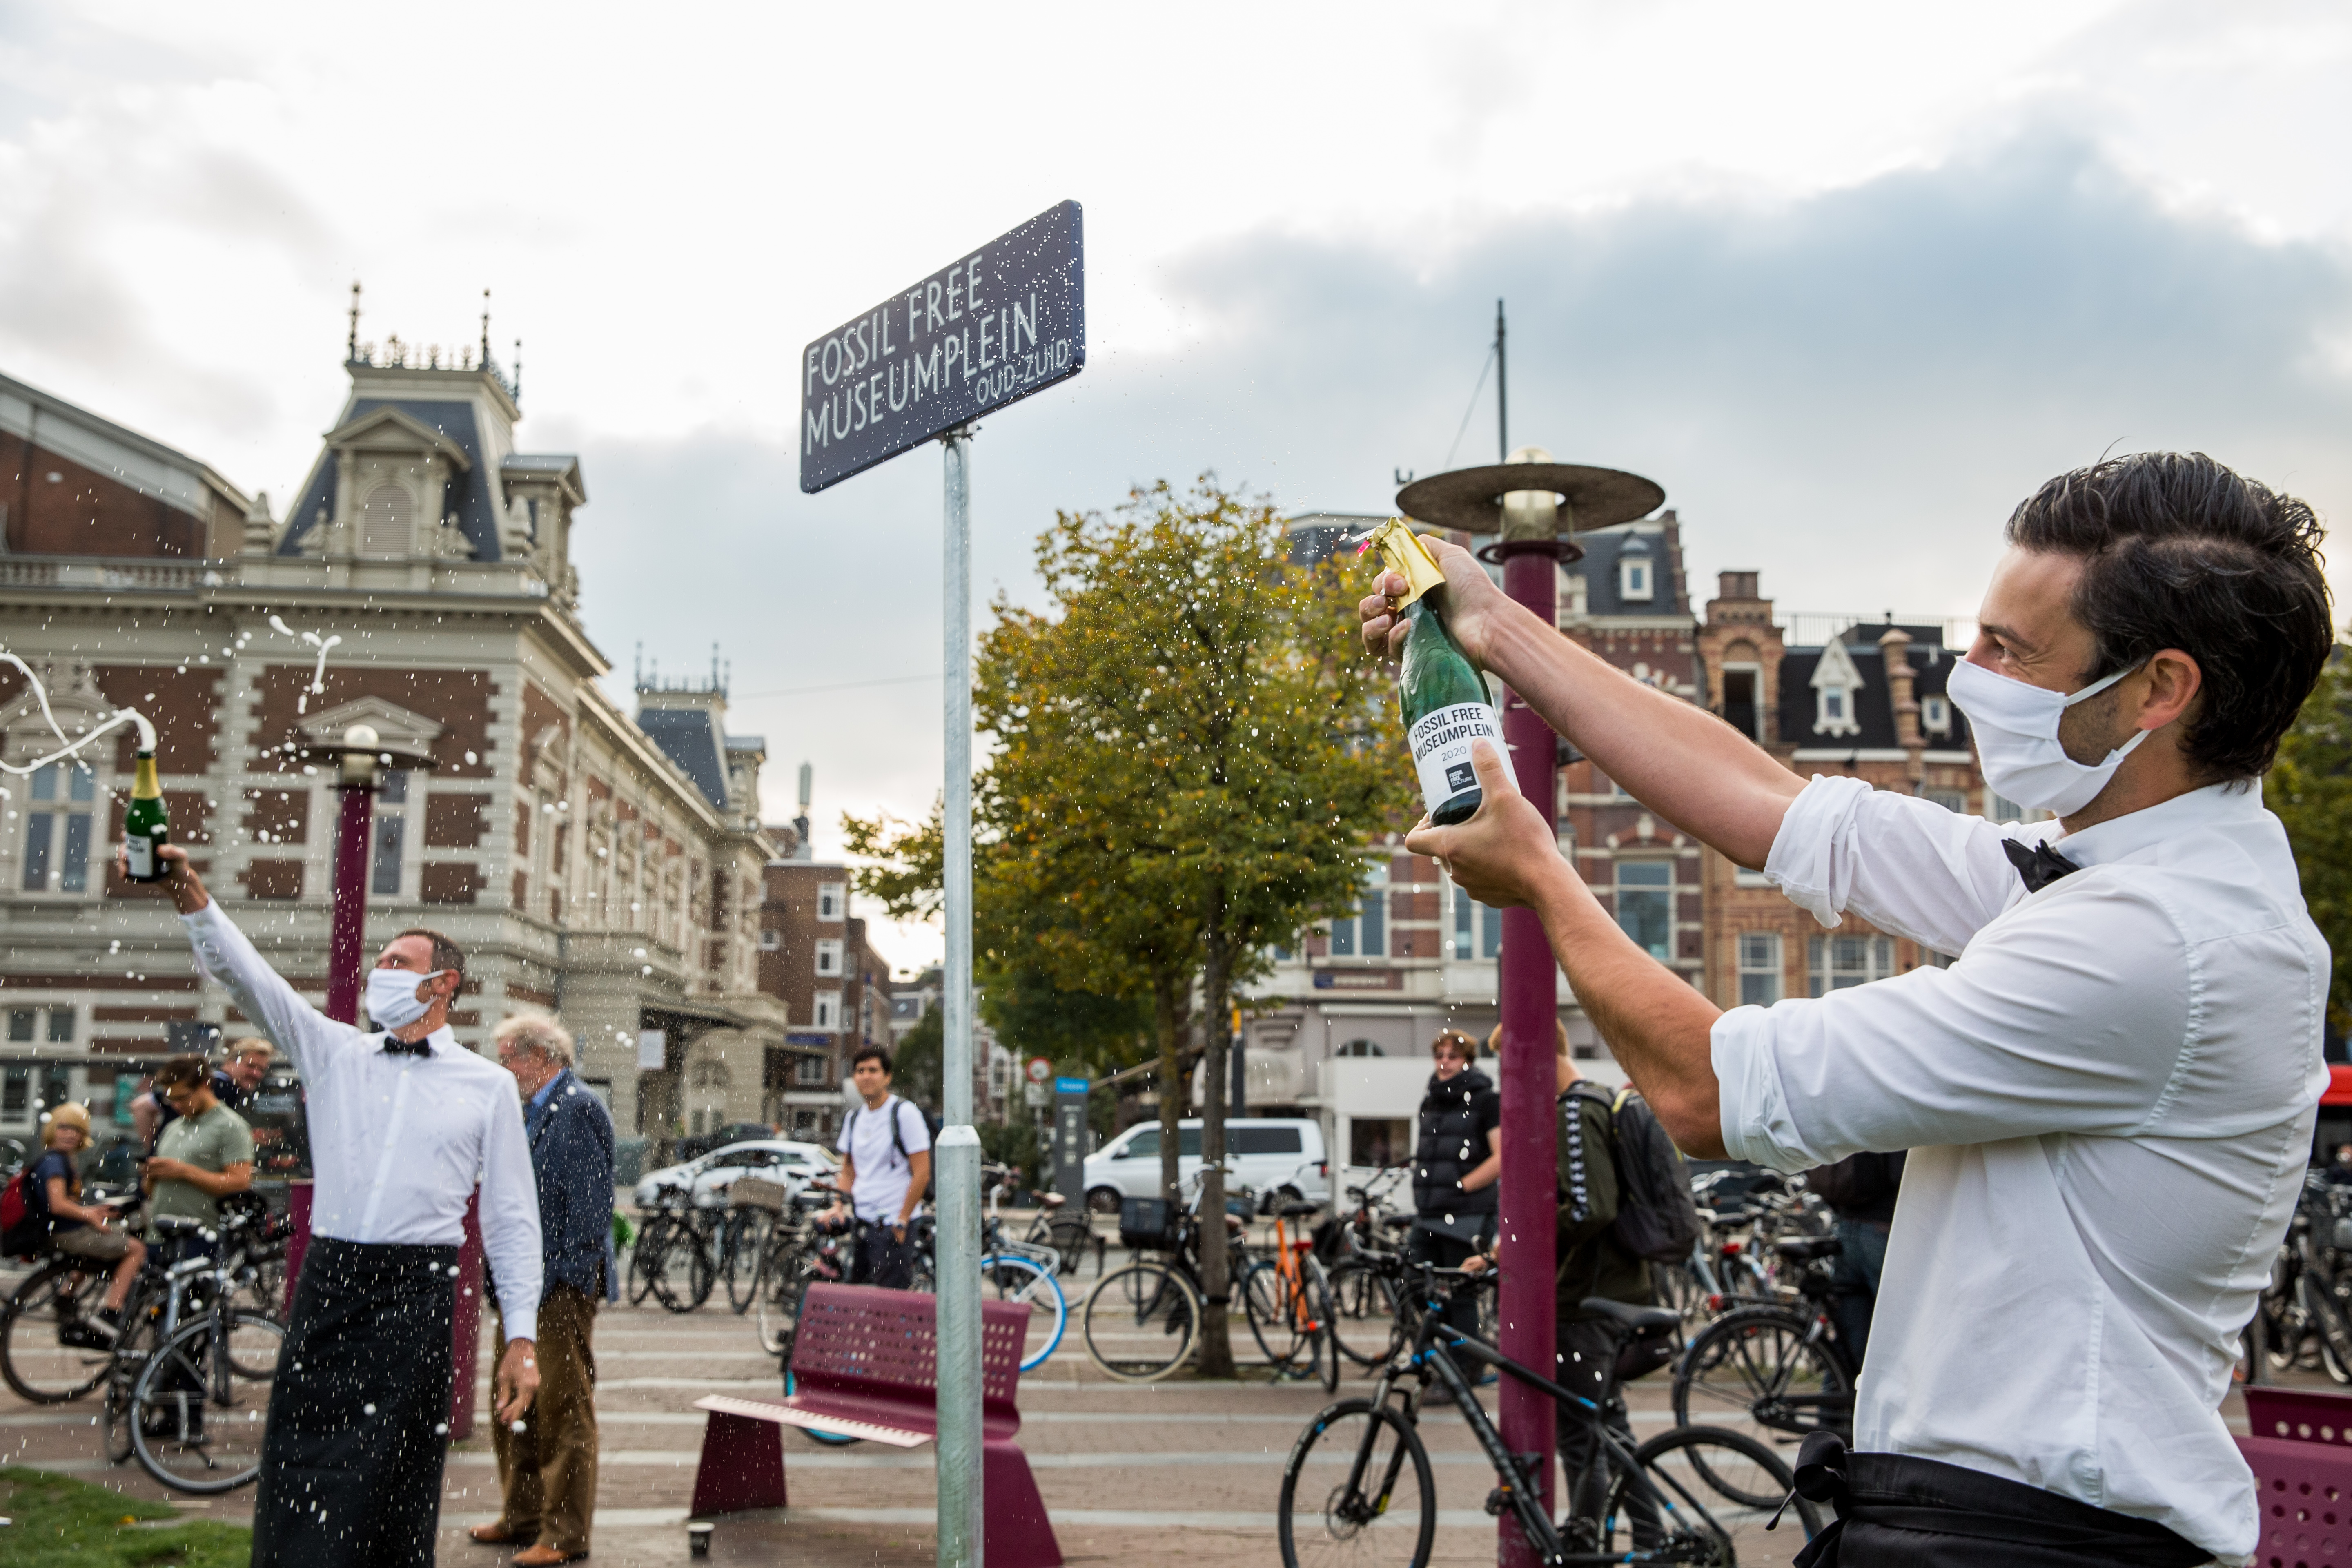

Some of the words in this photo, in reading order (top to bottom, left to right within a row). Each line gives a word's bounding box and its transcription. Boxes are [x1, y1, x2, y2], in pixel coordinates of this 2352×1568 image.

[807, 307, 896, 397] FOSSIL
[909, 254, 983, 343] FREE
[807, 292, 1036, 456] MUSEUMPLEIN
[976, 339, 1069, 404] OUD-ZUID
[1414, 713, 1450, 744] FOSSIL
[1452, 708, 1483, 722] FREE
[1415, 724, 1494, 764] MUSEUMPLEIN
[1441, 746, 1467, 762] 2020
[1452, 776, 1473, 787] CULTURE
